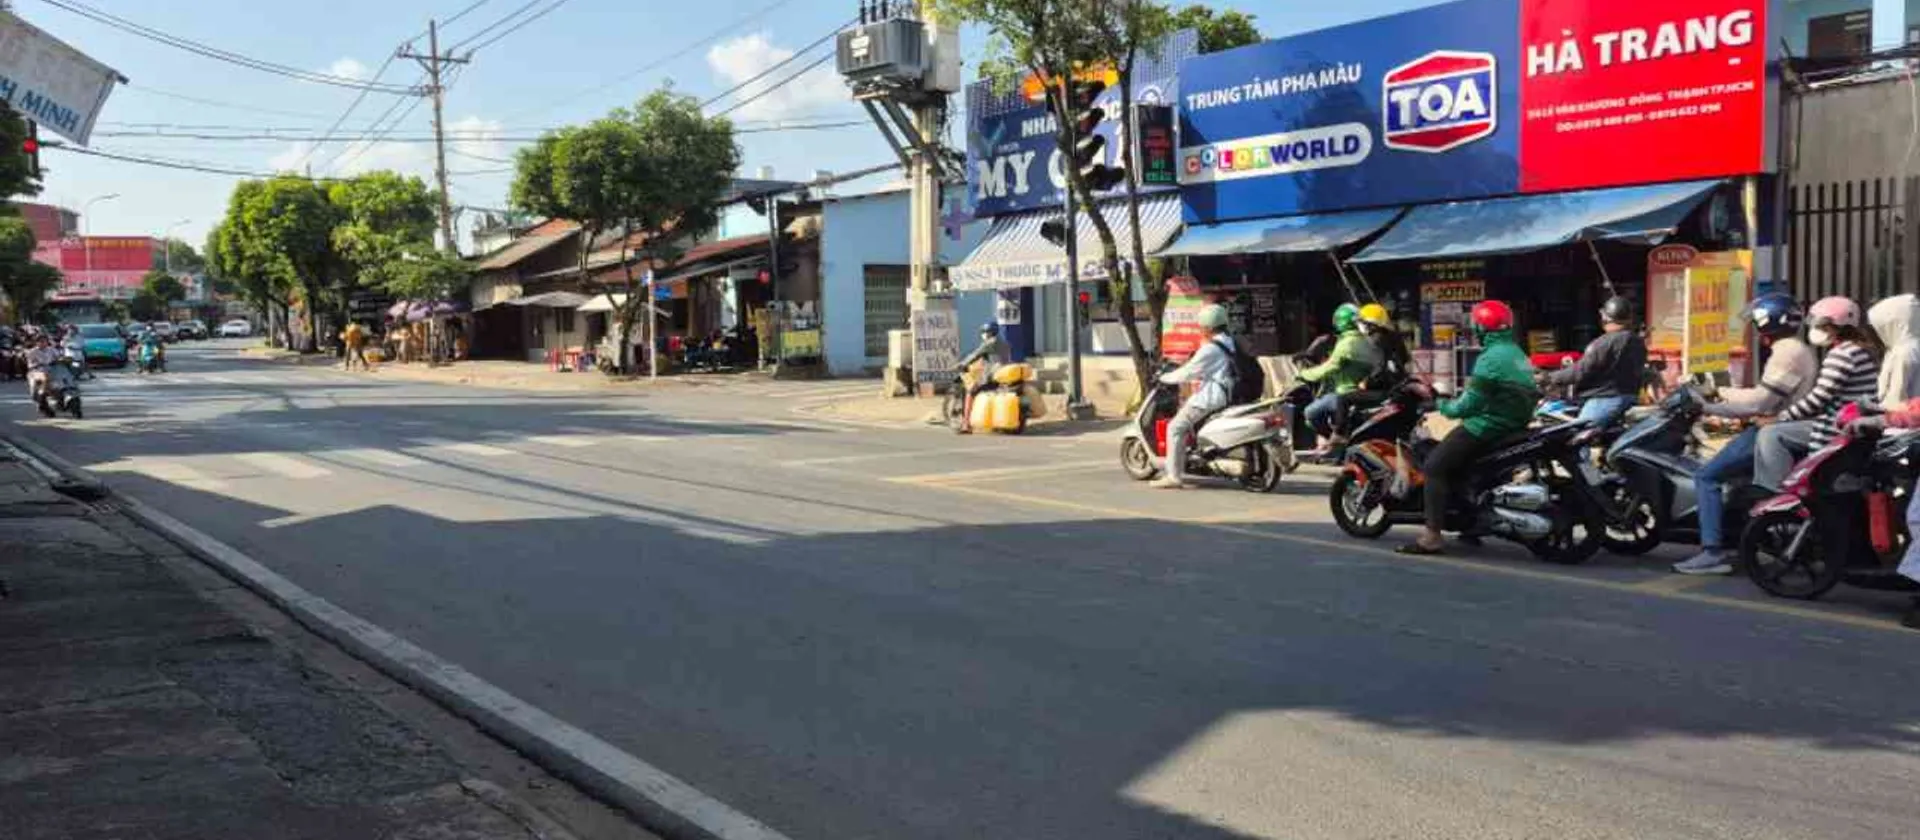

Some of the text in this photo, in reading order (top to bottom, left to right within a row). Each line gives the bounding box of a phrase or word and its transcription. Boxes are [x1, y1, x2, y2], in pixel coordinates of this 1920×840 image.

[1527, 9, 1754, 77] HÀ TRANG
[1186, 61, 1363, 111] TRUNG TÂM PHA MÀU
[1390, 78, 1487, 126] TOA
[20, 90, 80, 132] MINH
[978, 151, 1035, 199] MY
